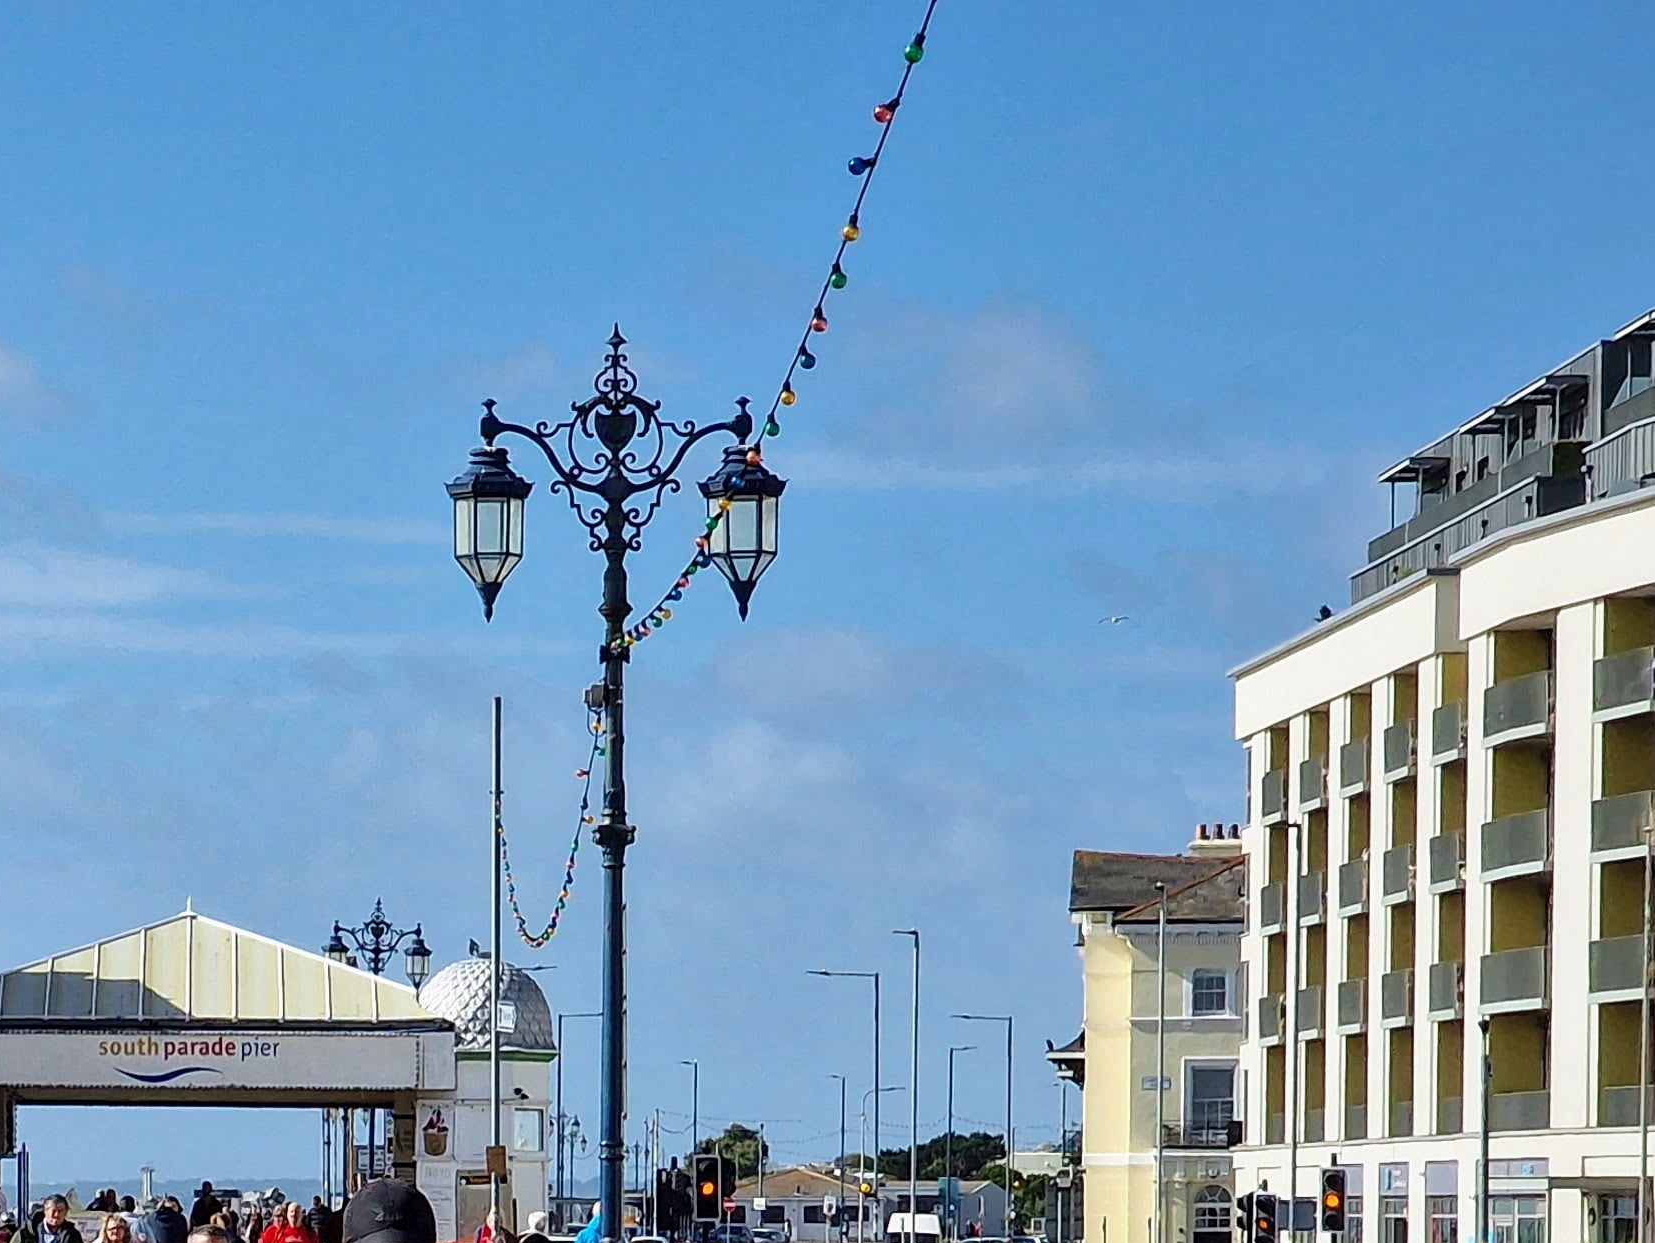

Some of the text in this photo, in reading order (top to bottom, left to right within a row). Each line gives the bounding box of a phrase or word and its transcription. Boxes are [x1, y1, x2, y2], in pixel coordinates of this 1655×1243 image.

[99, 1036, 280, 1061] south parade pier
